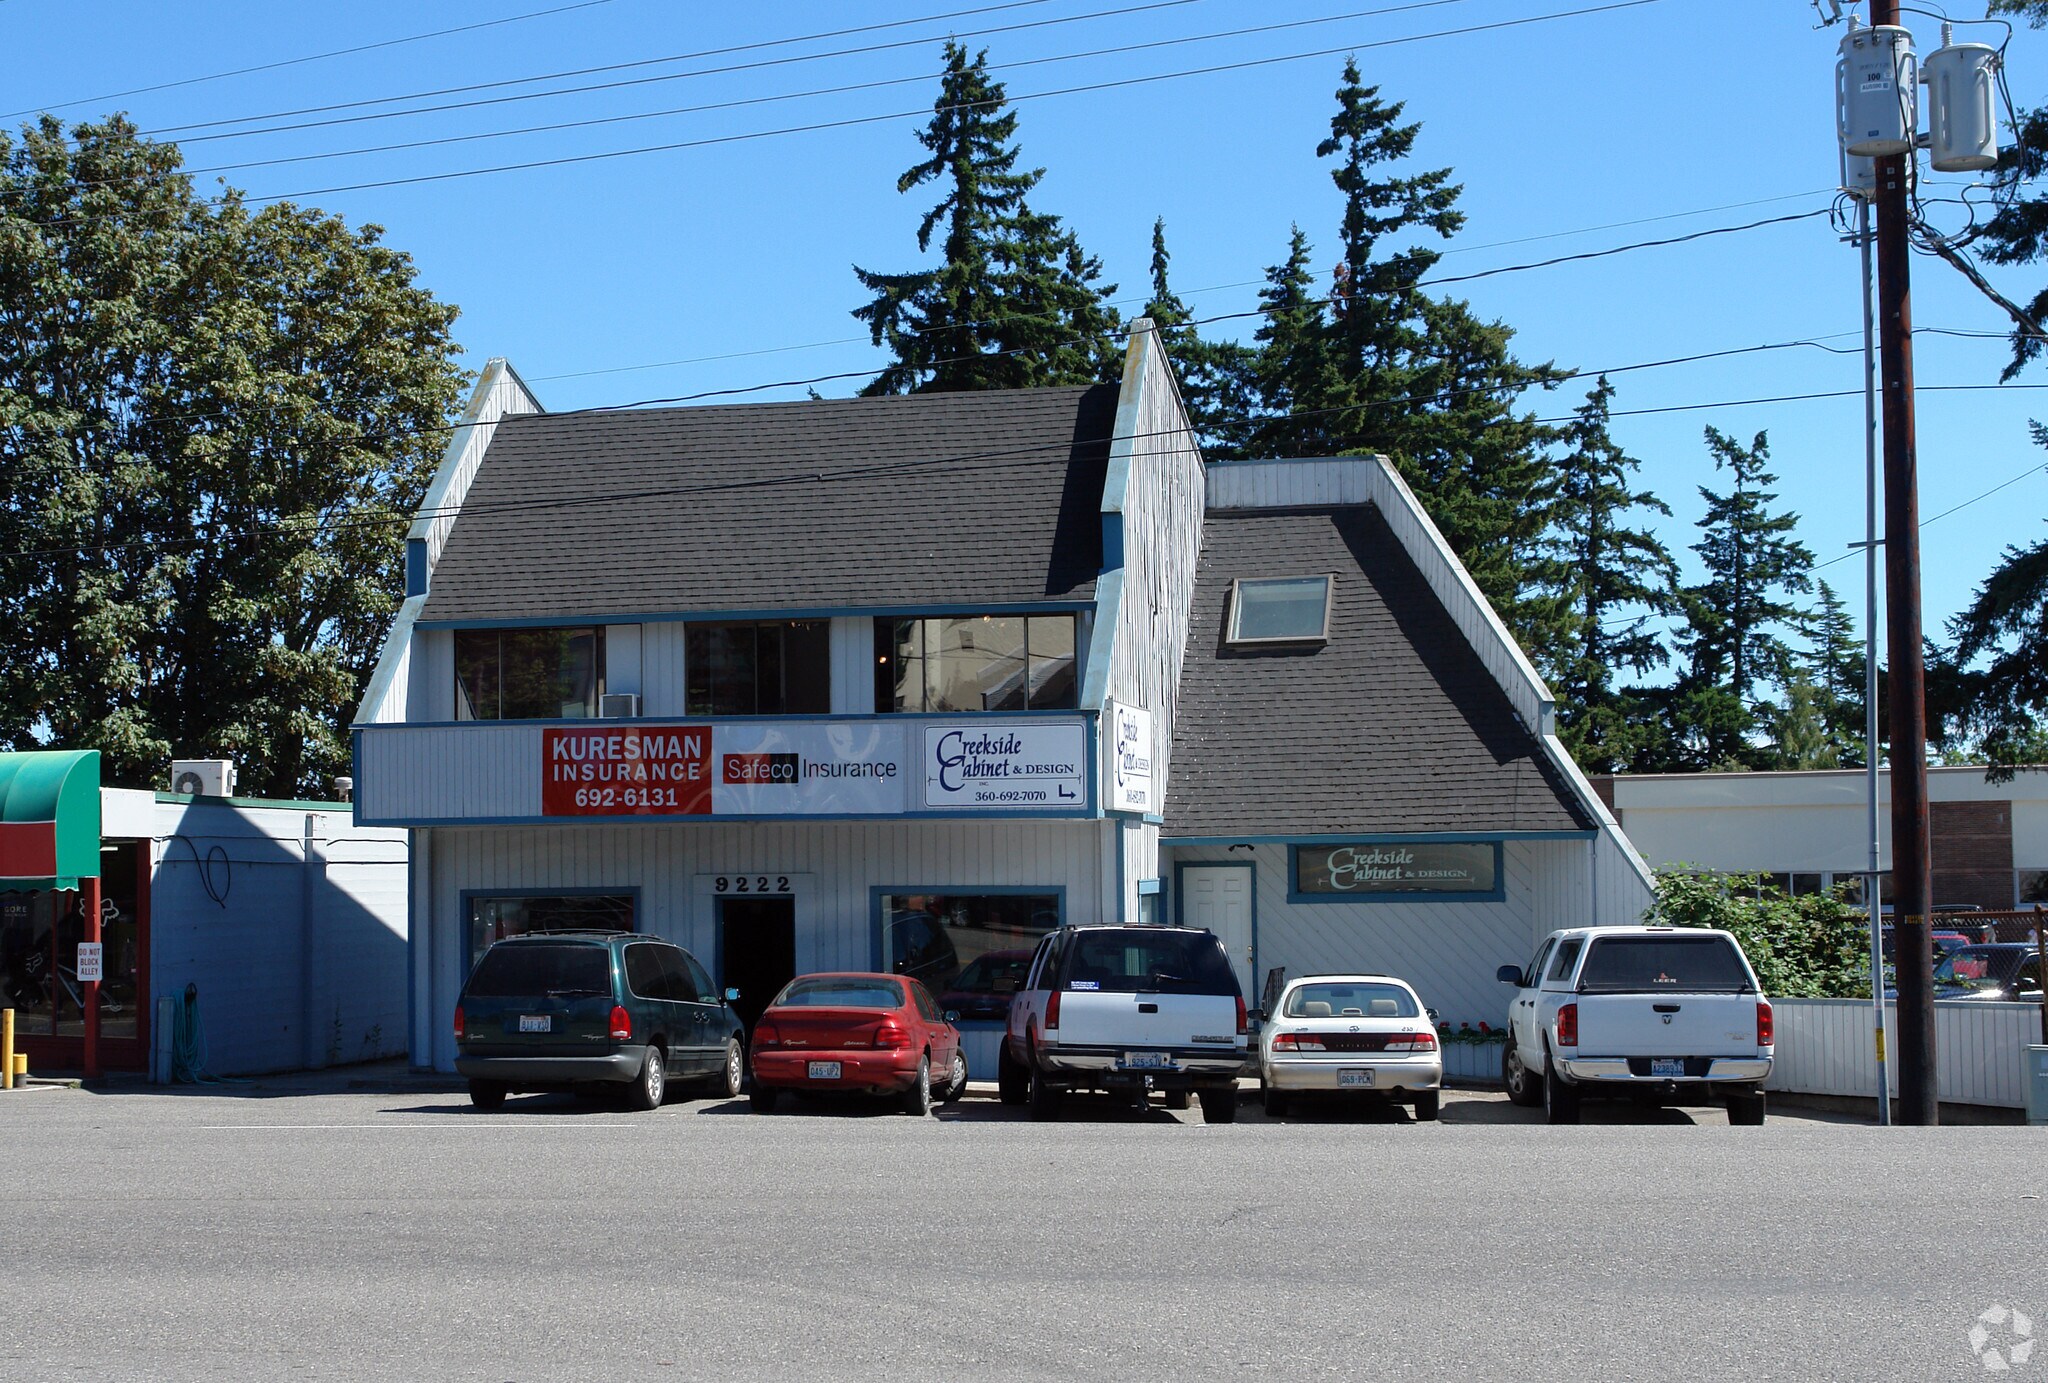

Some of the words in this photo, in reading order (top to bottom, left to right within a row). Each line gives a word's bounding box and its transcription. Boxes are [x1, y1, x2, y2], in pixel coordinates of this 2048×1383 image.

[553, 735, 701, 760] KURESMAN
[936, 731, 1022, 766] Creekside
[553, 762, 700, 782] INSURANCE
[728, 759, 793, 778] Safeco
[803, 759, 897, 778] Insurance
[939, 755, 1010, 792] Cabinet
[1012, 766, 1022, 774] &
[1026, 764, 1074, 774] DESIGN
[575, 788, 678, 807] 692-6131
[975, 791, 1047, 802] 360-692-7070
[1327, 847, 1414, 873] Creekside
[715, 876, 790, 892] 9222
[1330, 864, 1402, 889] Cabinet
